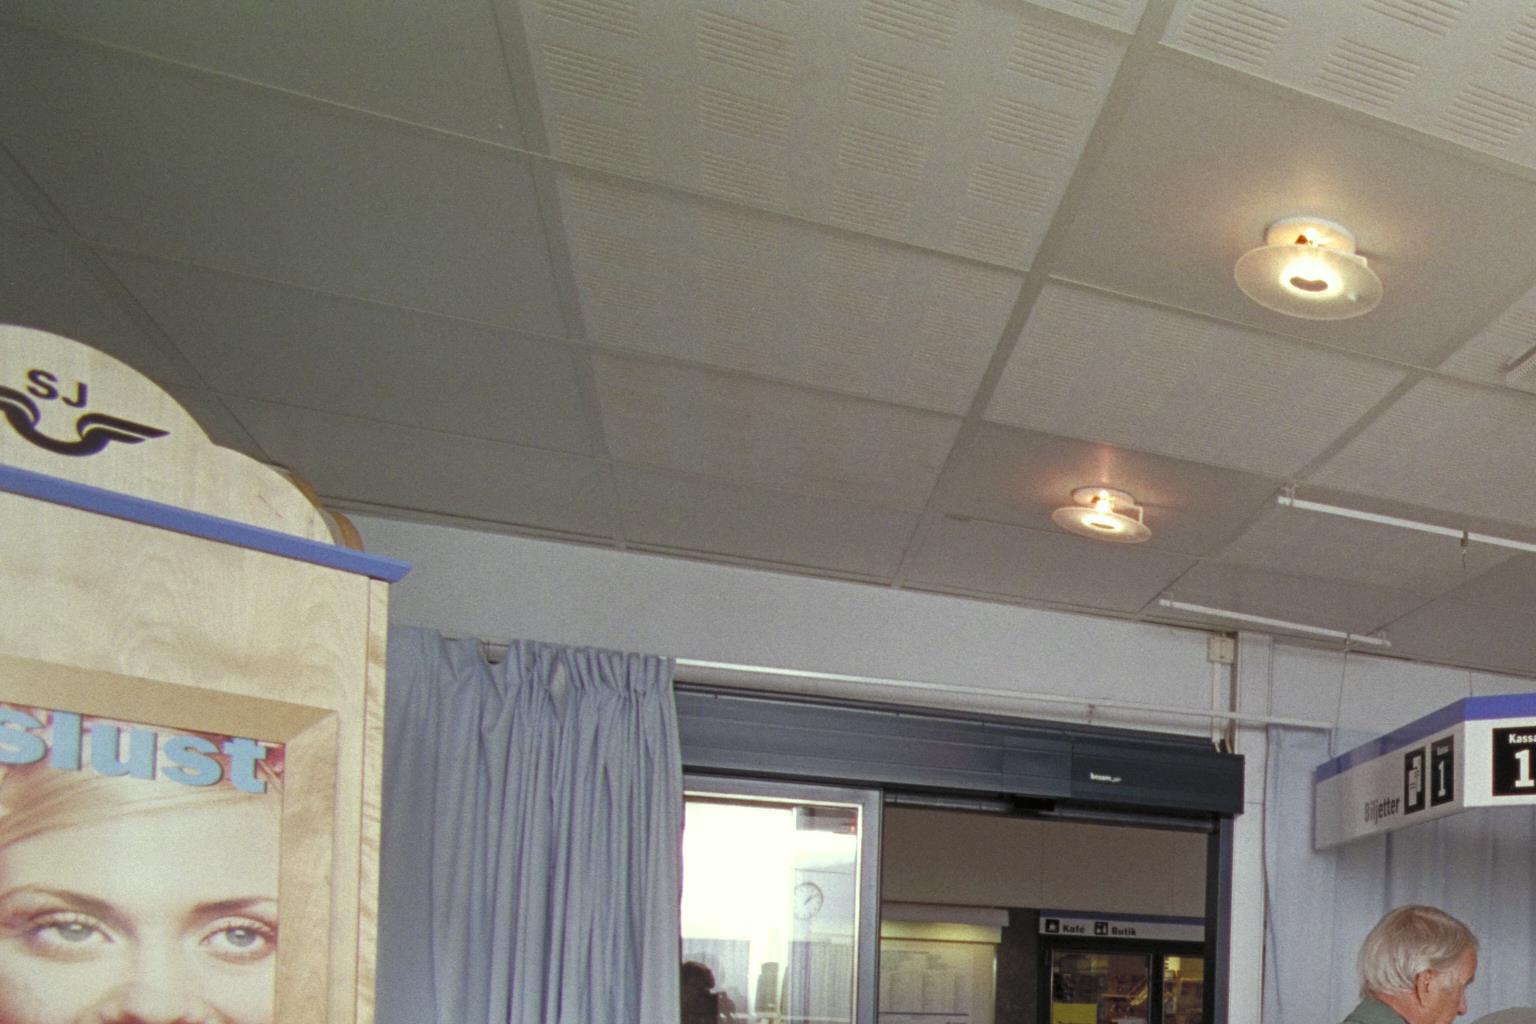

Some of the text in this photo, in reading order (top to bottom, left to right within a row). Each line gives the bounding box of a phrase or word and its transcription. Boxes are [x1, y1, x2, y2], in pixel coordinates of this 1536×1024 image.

[26, 368, 88, 409] SJ
[1437, 760, 1446, 797] 1
[1515, 749, 1535, 788] 1
[1364, 797, 1400, 823] Biljetter
[1112, 926, 1136, 936] Butik
